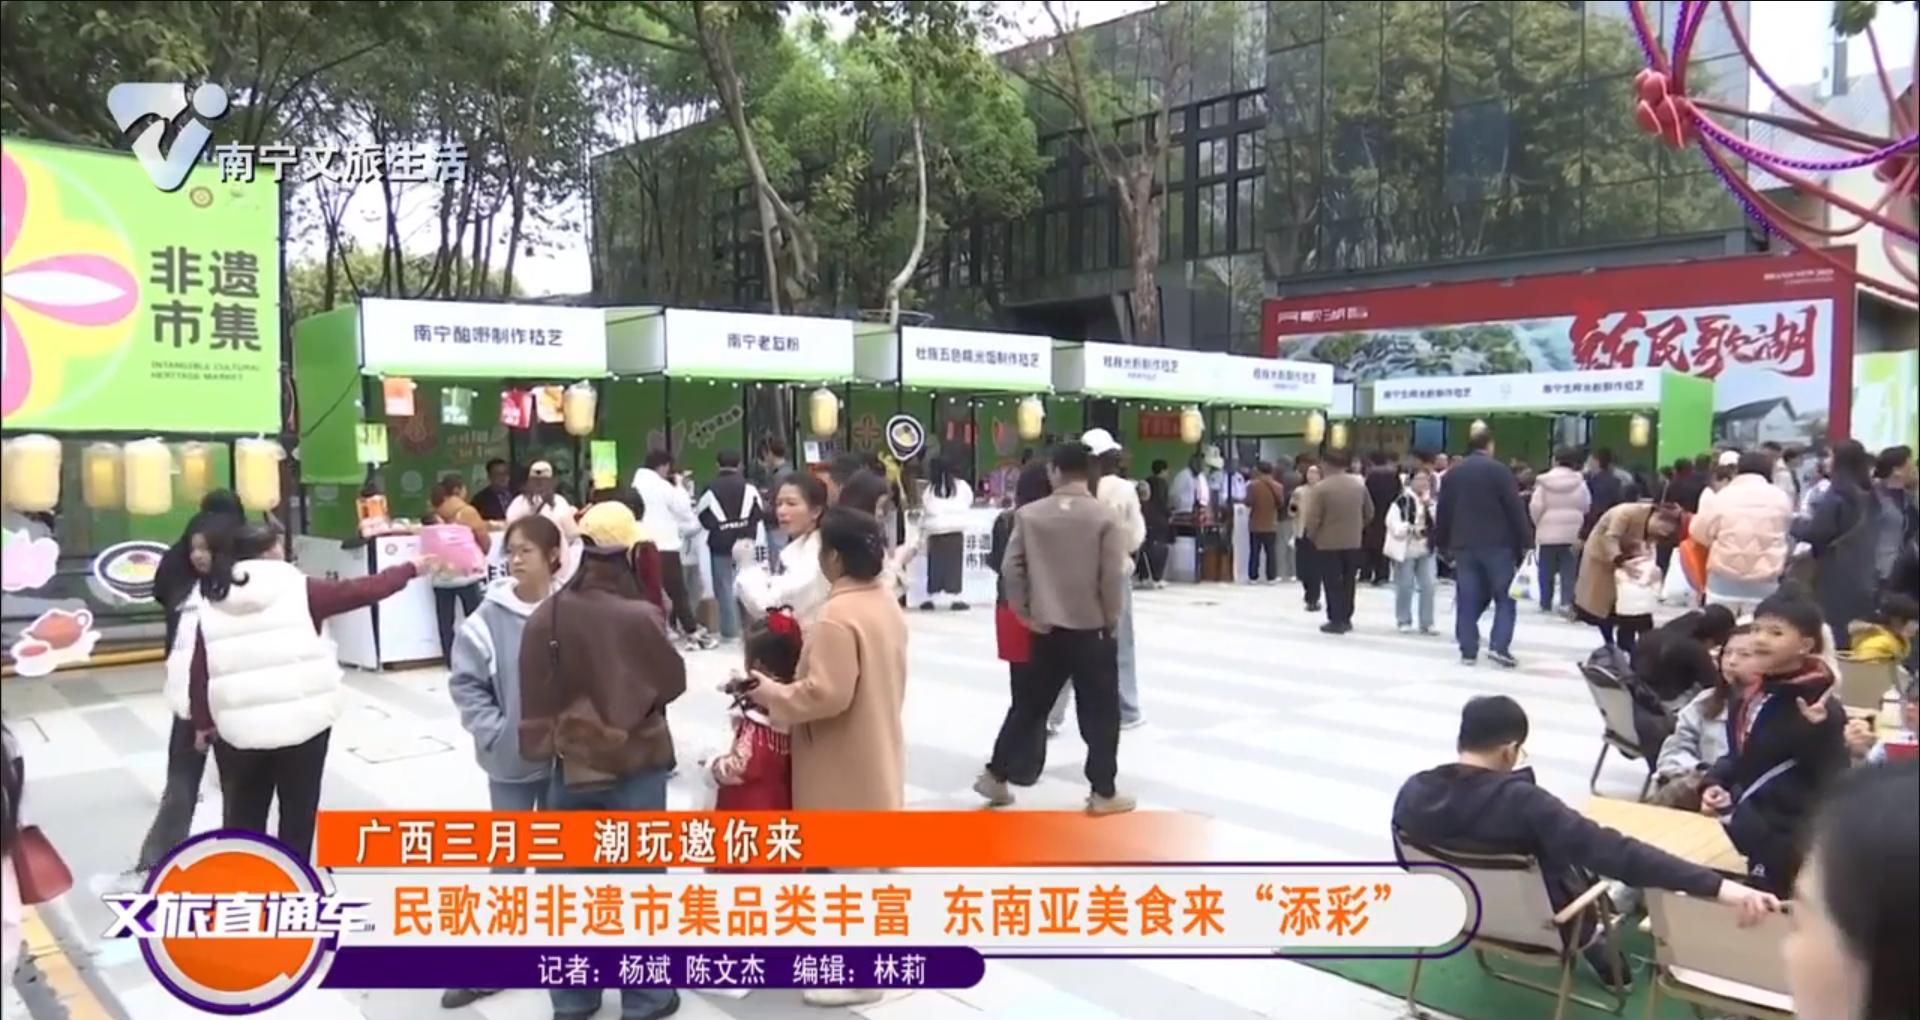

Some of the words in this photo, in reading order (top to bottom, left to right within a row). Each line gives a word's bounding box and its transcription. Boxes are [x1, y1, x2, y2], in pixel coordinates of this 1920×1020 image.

[150, 246, 260, 298] 非遗
[150, 299, 262, 351] 市集
[727, 333, 800, 352] 南宁老友粉
[1569, 296, 1818, 382] 新民歌湖
